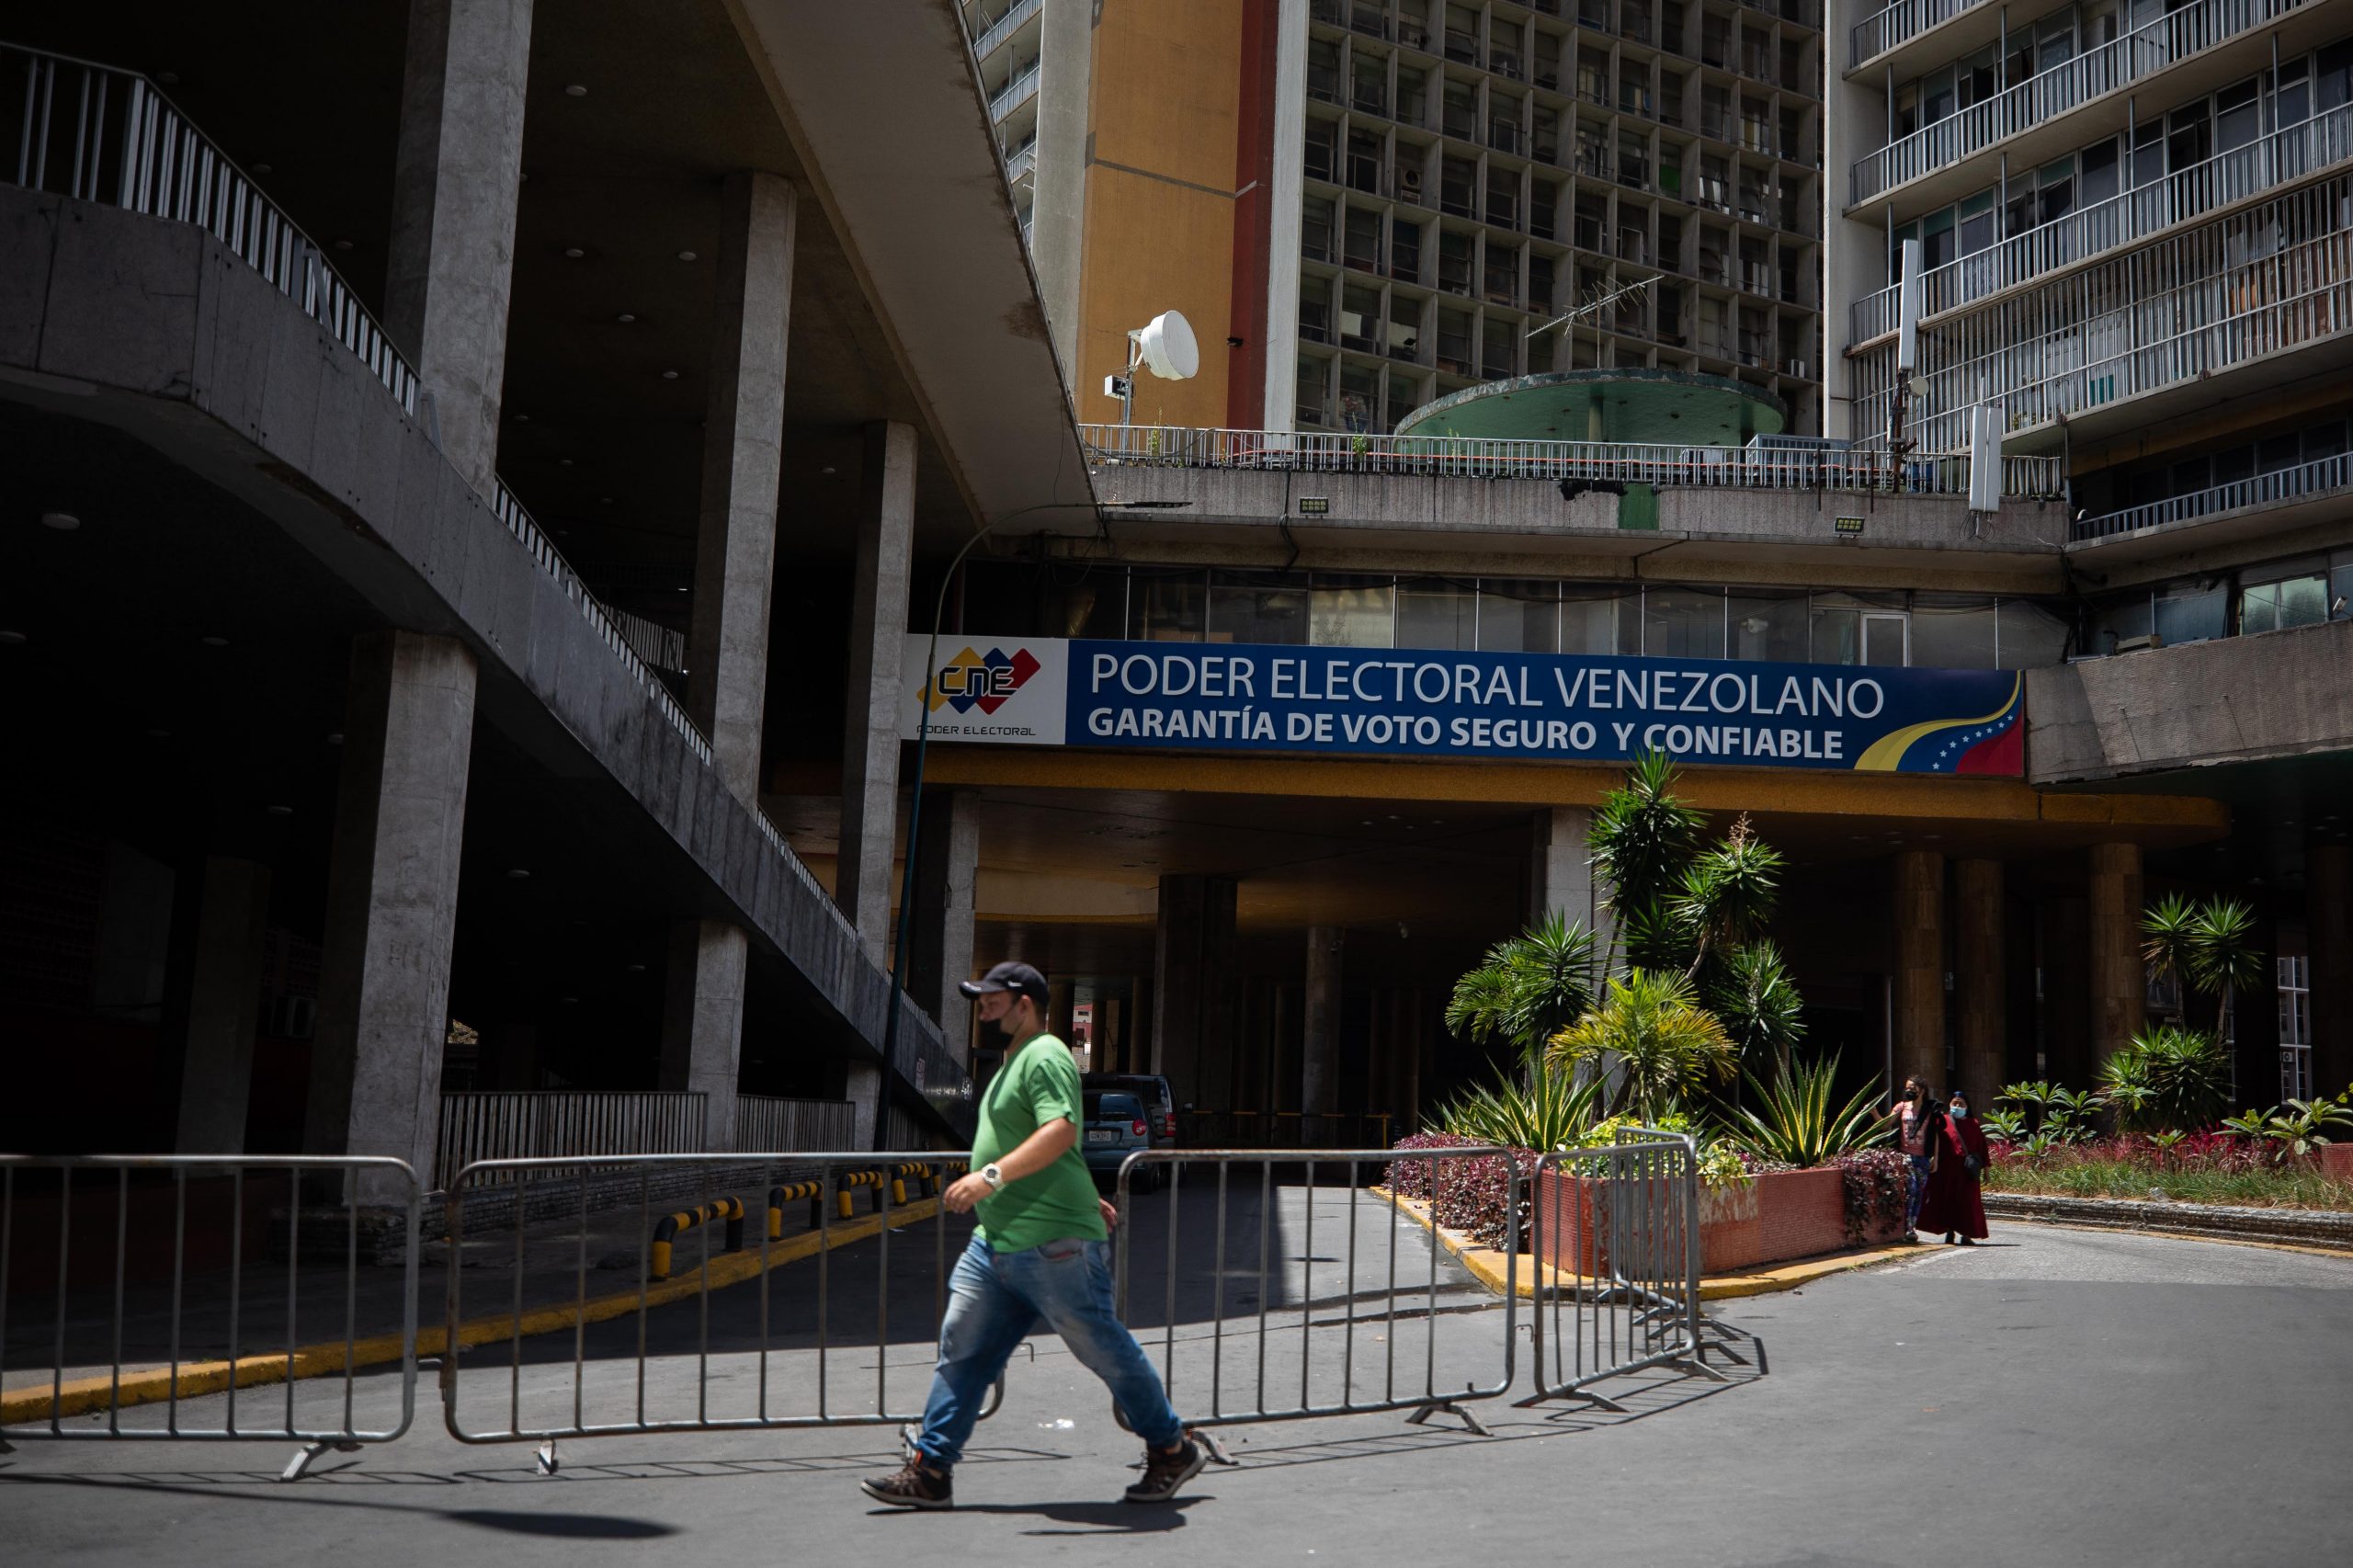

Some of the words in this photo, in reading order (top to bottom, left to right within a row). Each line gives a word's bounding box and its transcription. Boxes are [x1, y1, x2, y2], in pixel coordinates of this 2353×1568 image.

[1092, 653, 1255, 698] PODER
[1271, 658, 1544, 707] ELECTORAL
[1553, 667, 1884, 719] VENEZOLANO
[1088, 705, 1277, 741] GARANTÍA
[1287, 712, 1334, 742] DE
[1341, 715, 1441, 744] VOTO
[1450, 718, 1597, 750] SEGURO
[1611, 722, 1635, 752] Y
[1643, 723, 1843, 759] CONFIABLE
